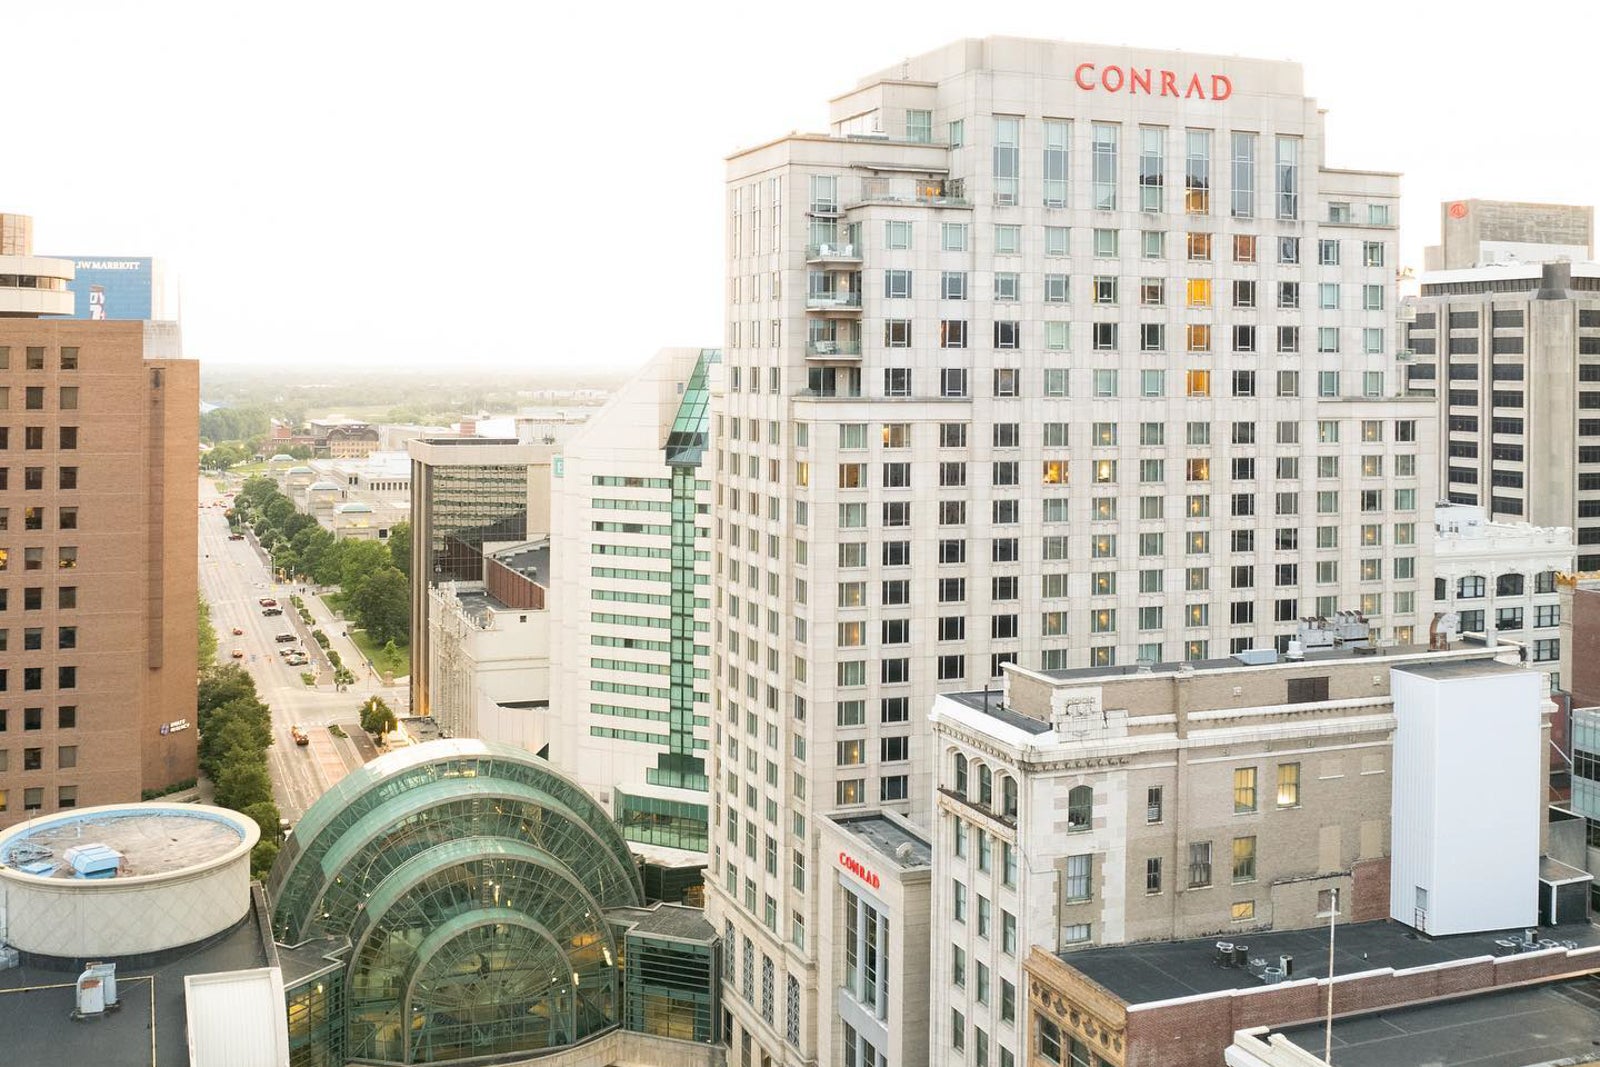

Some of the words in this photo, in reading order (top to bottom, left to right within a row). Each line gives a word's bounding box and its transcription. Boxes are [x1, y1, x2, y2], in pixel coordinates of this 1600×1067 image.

[1074, 62, 1232, 101] CONRAD
[91, 261, 141, 270] MARRIOTT
[839, 852, 880, 889] CONRAD
